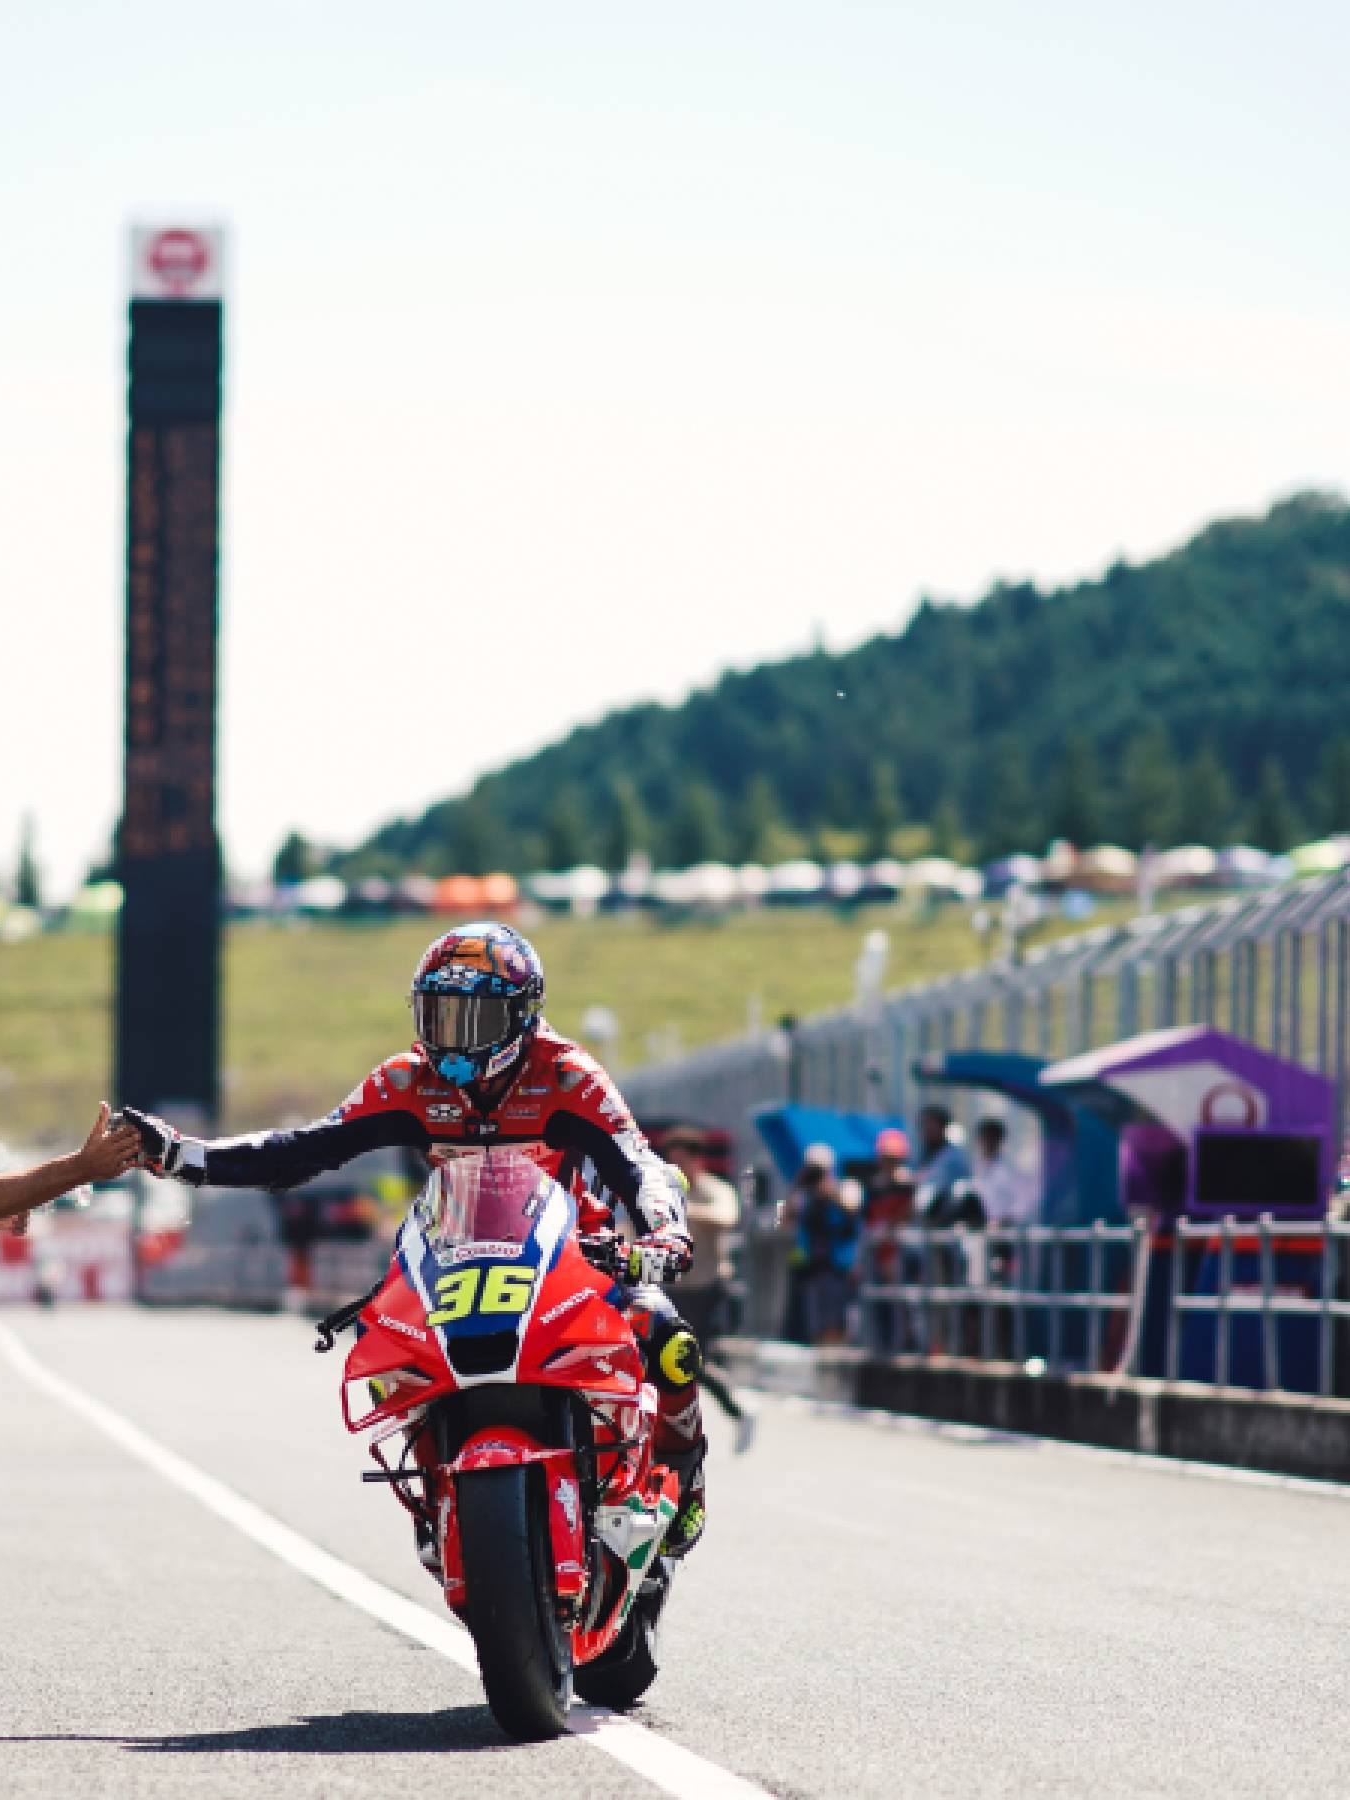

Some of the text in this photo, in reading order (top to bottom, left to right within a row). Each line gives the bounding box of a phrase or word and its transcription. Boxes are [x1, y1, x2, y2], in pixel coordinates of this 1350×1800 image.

[427, 1265, 536, 1327] 36
[539, 1286, 598, 1324] HONDA
[377, 1313, 427, 1342] HONDA
